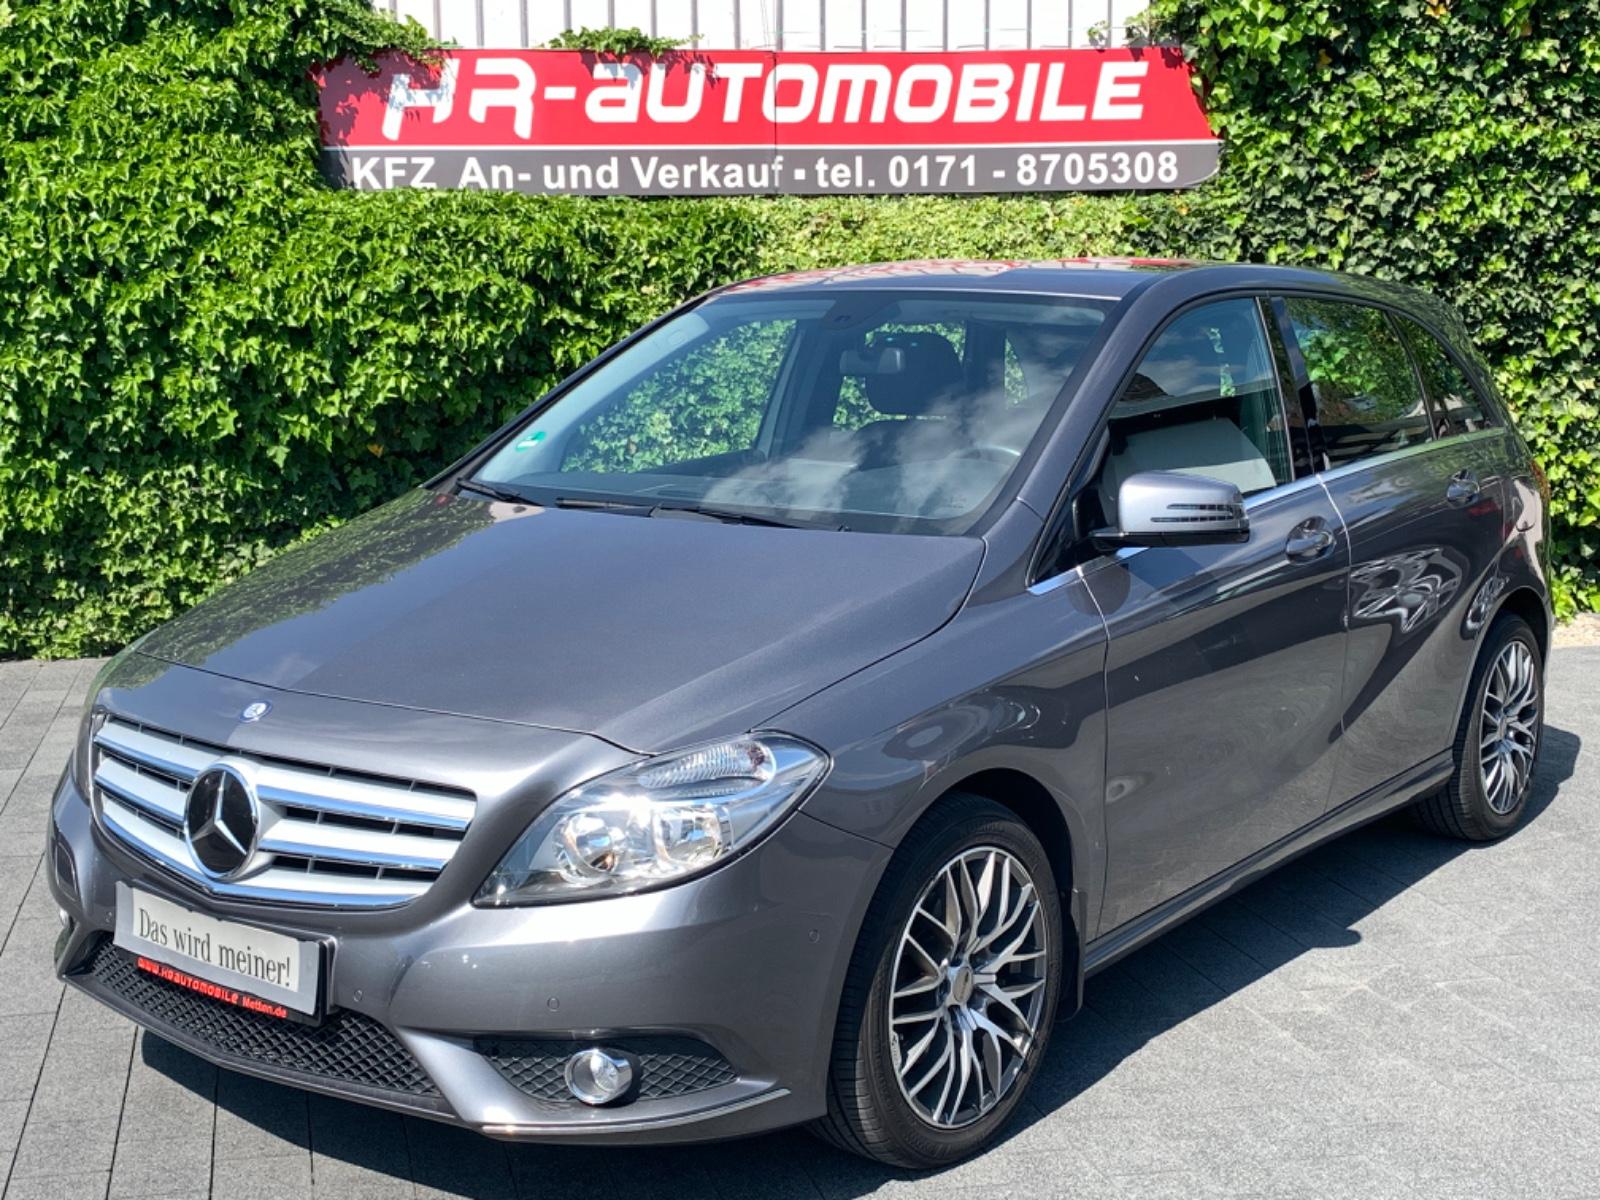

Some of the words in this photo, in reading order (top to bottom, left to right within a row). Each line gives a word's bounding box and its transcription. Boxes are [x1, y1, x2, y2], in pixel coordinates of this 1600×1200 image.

[352, 156, 437, 189] KFZ
[459, 156, 531, 189] An-
[543, 156, 620, 190] und
[631, 155, 784, 190] Verkauf
[815, 155, 875, 188] tel.
[888, 154, 977, 188] 0171
[1016, 150, 1179, 186] 8705308
[138, 907, 168, 946] Das
[173, 927, 212, 963] wird
[218, 943, 291, 987] meiner!
